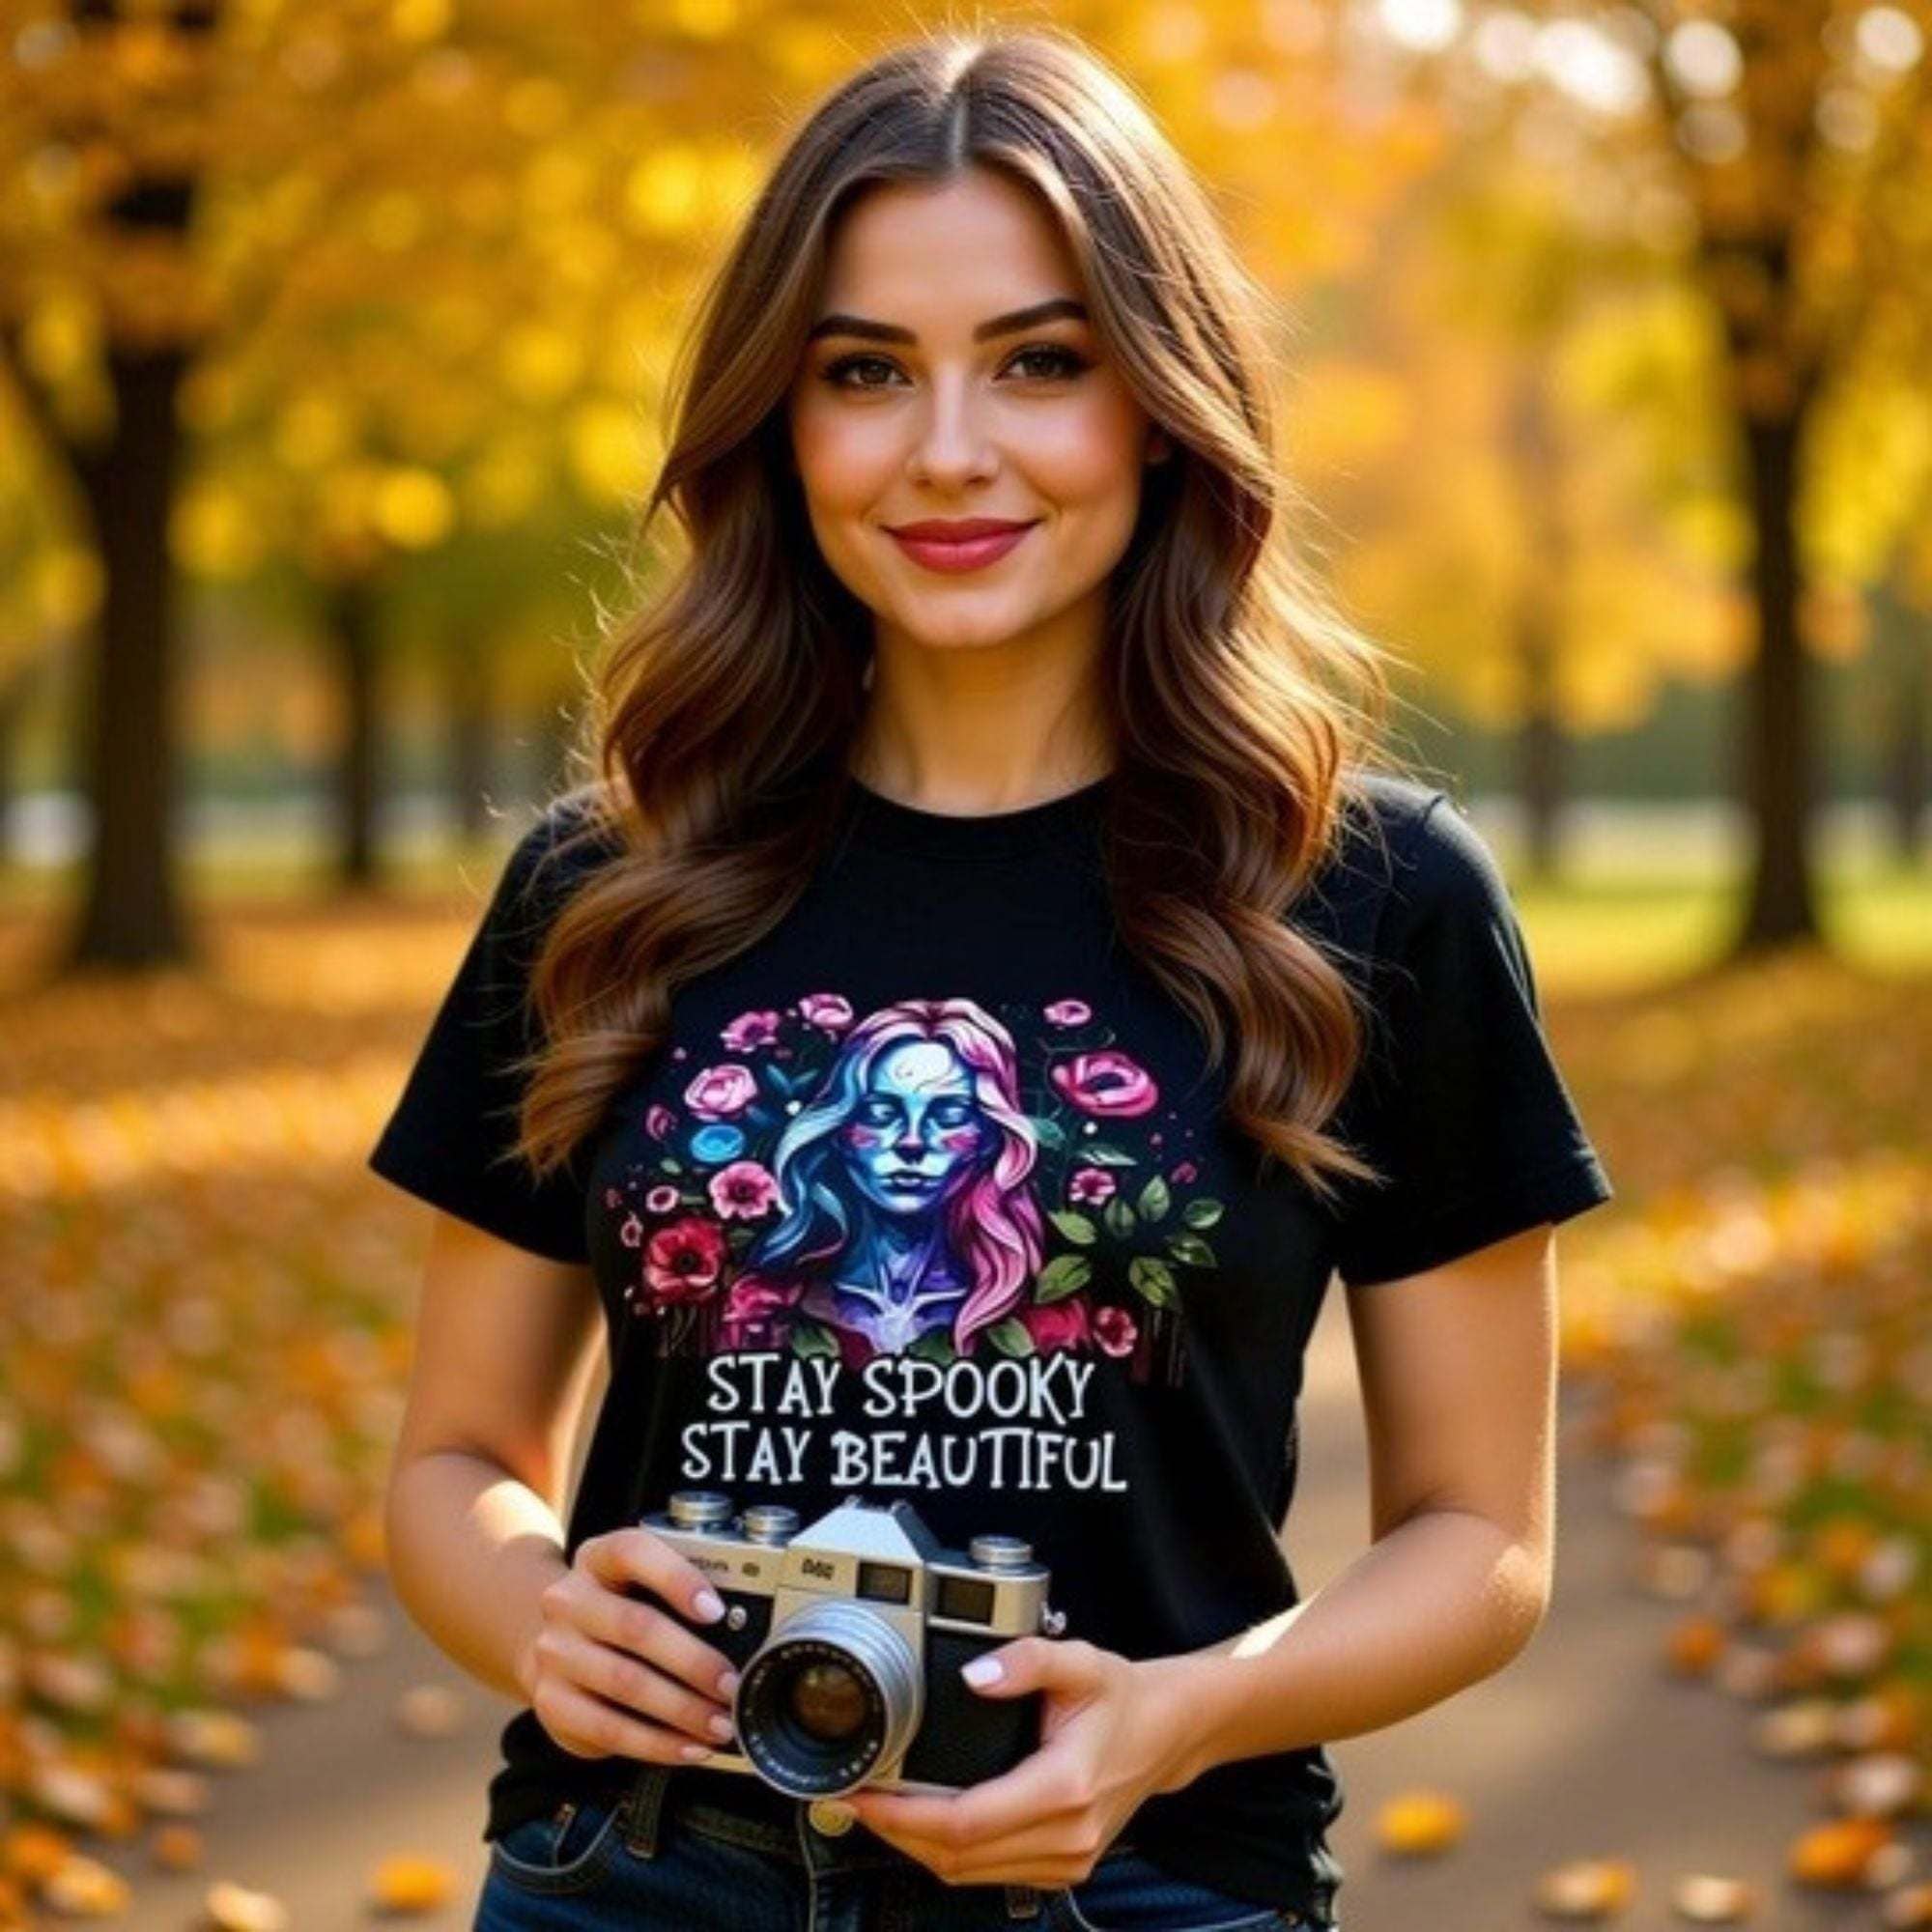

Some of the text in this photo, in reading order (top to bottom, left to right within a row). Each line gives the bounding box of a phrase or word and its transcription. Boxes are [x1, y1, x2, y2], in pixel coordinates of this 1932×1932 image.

[706, 1351, 1094, 1424] STAY SPOOKY
[680, 1422, 1128, 1492] STAY BEAUTIFUL
